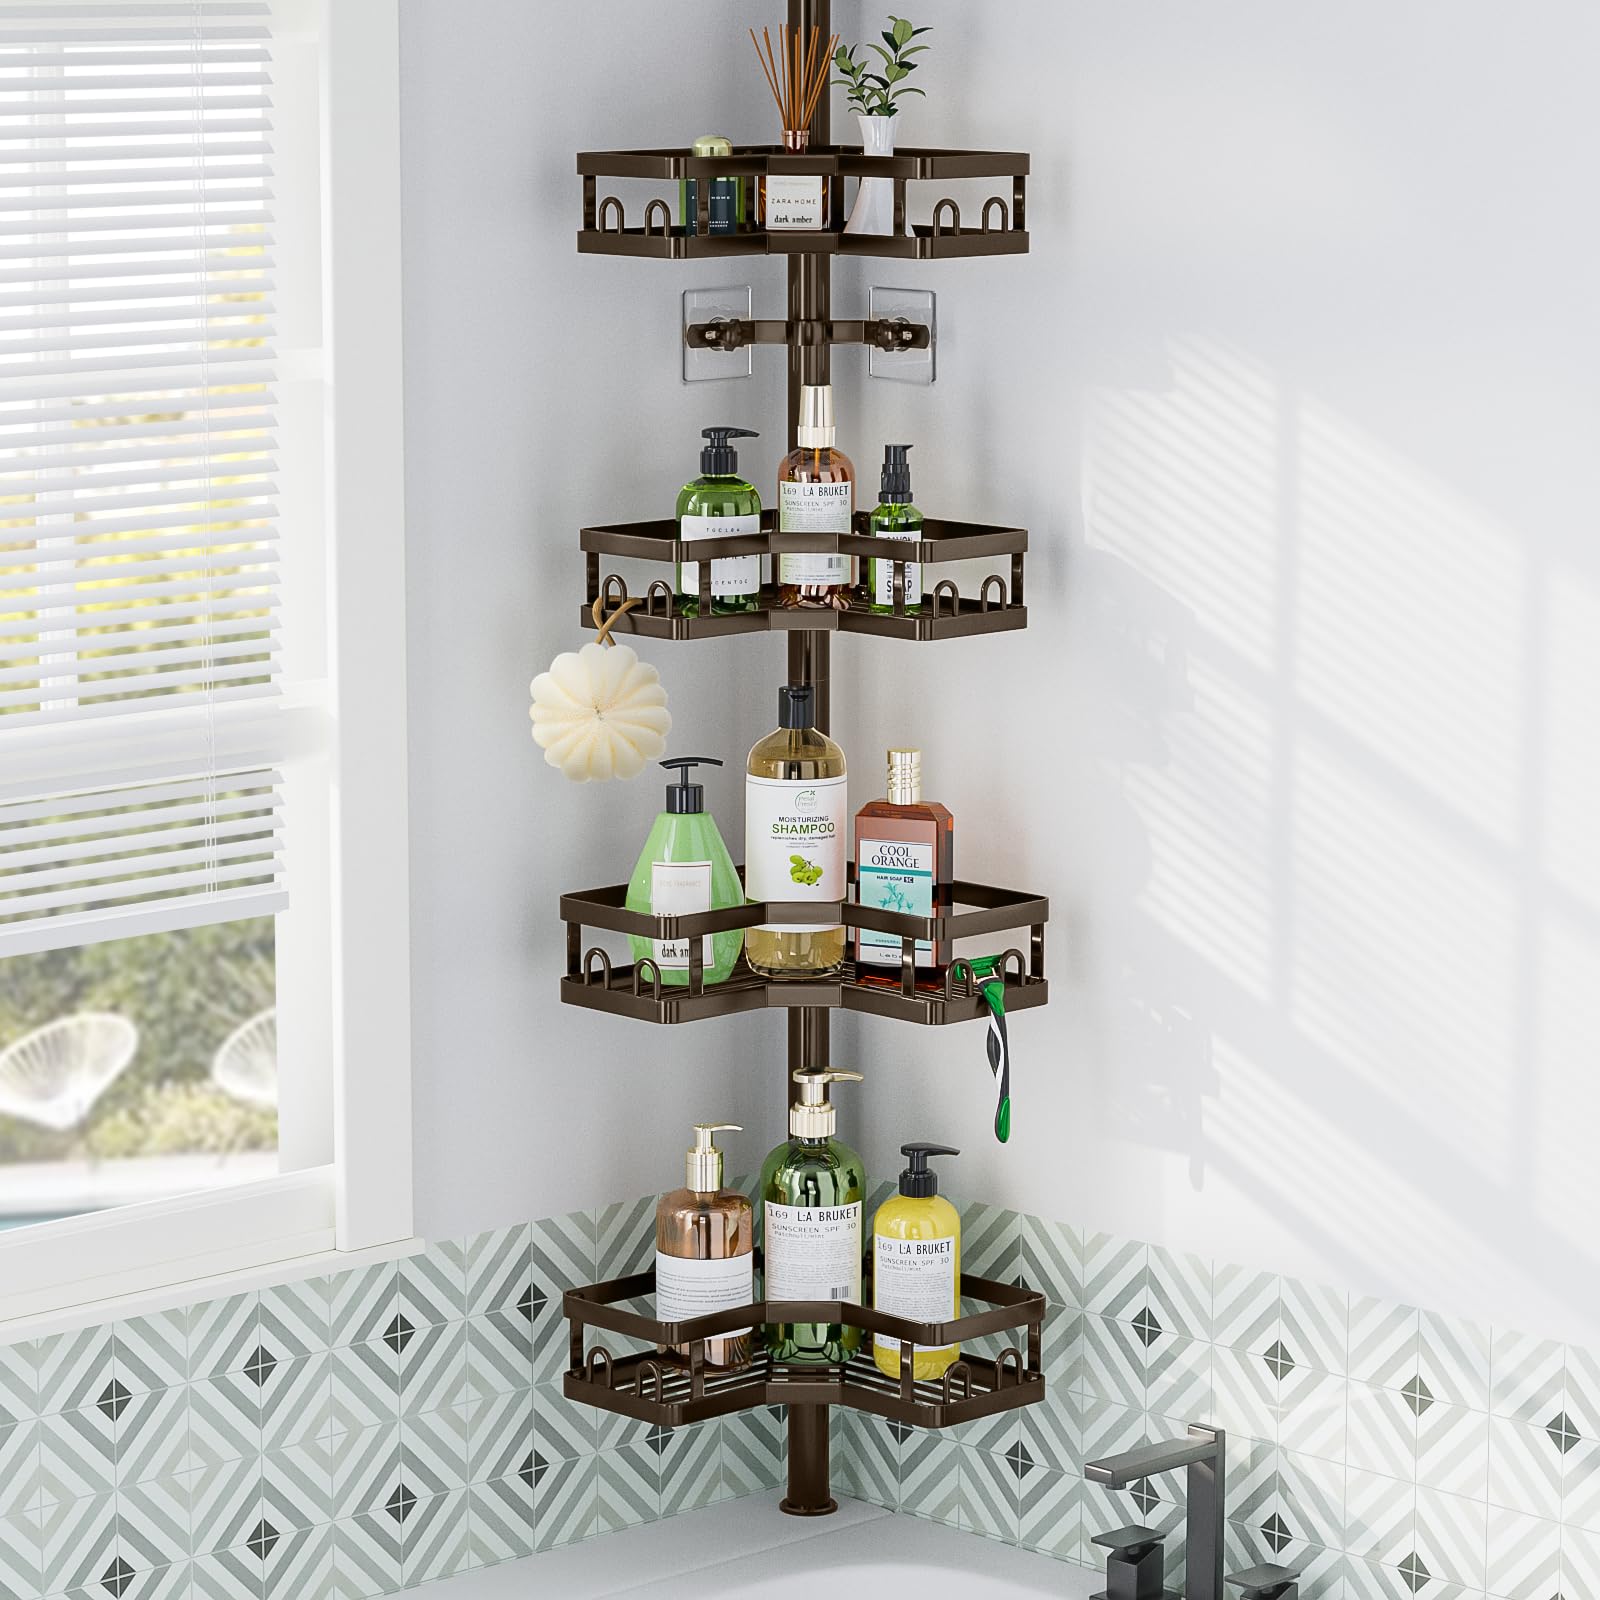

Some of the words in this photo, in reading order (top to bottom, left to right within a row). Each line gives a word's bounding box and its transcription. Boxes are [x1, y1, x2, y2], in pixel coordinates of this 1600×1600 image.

[774, 215, 789, 223] dark
[792, 215, 813, 223] amber
[783, 487, 797, 496] 169
[818, 485, 849, 497] BRUKET
[886, 580, 913, 593] SP
[772, 823, 835, 835] SHAMPOO
[879, 845, 912, 858] COOL
[871, 855, 920, 868] ORANGE
[661, 943, 678, 958] dark
[768, 1208, 788, 1220] 169
[819, 1206, 858, 1222] BRUKET
[771, 1222, 820, 1233] SUNSCREEN
[846, 1221, 857, 1231] 30
[878, 1240, 893, 1252] 169
[916, 1240, 951, 1255] BRUKET
[880, 1256, 918, 1267] SUNSCREEN
[921, 1259, 935, 1267] SPF
[939, 1256, 950, 1265] 30
